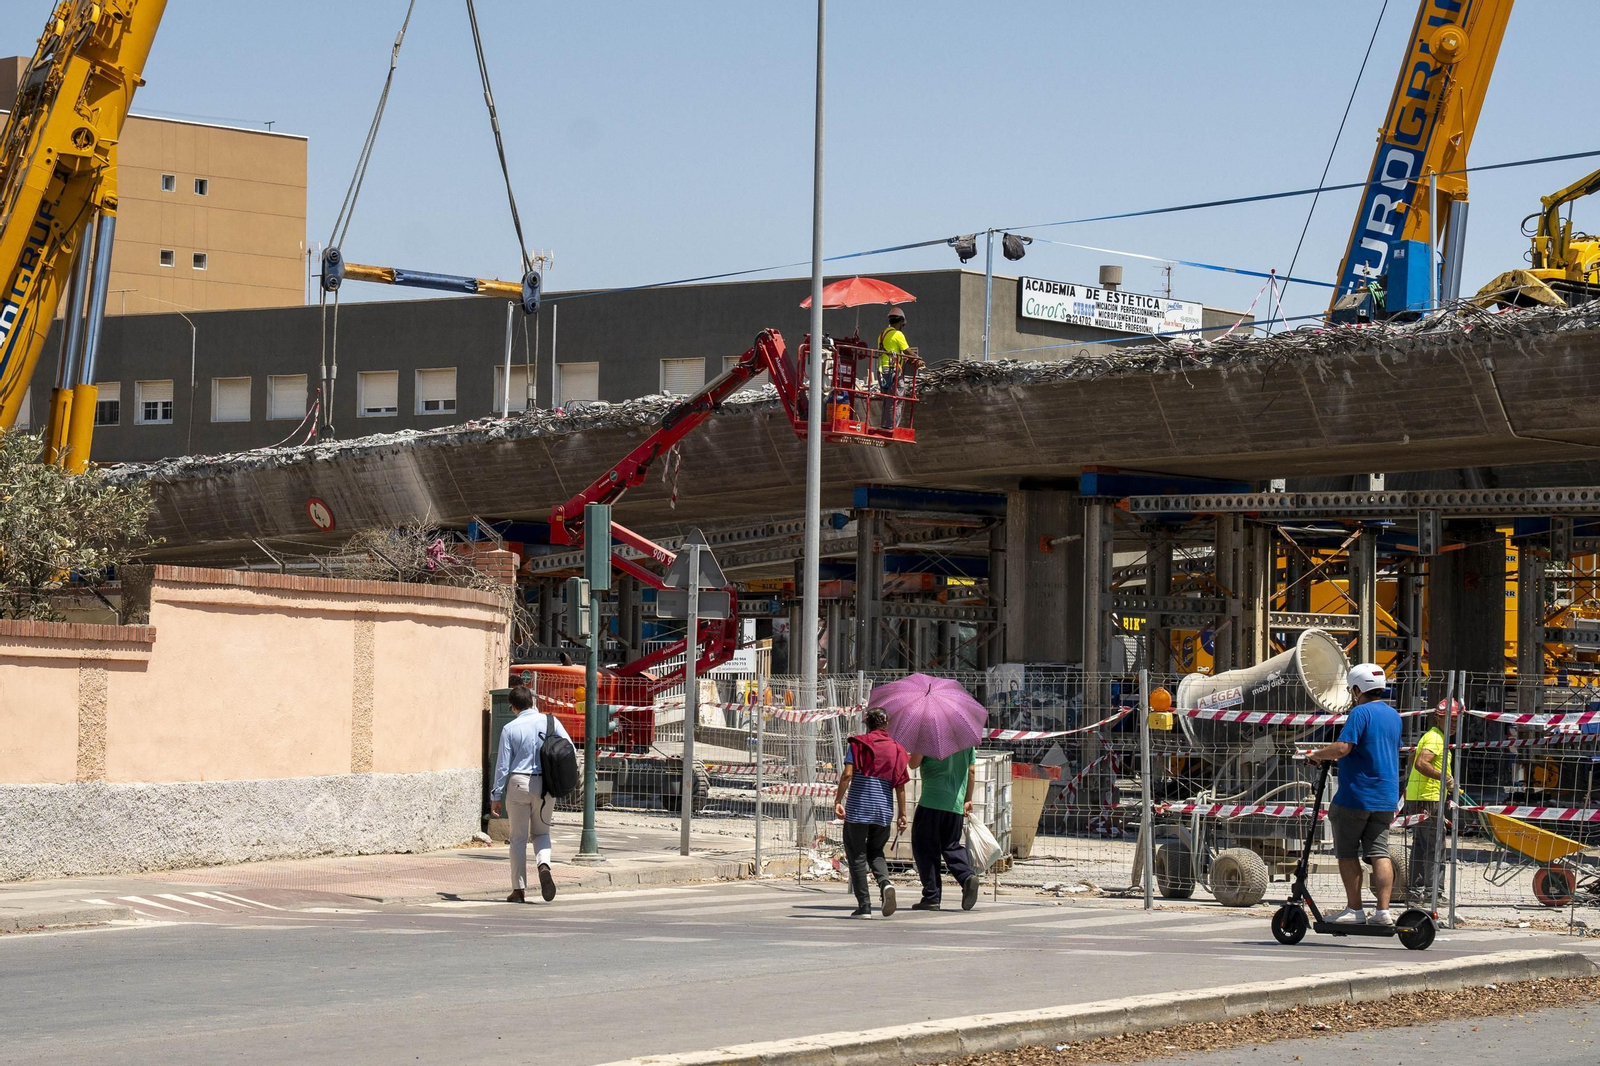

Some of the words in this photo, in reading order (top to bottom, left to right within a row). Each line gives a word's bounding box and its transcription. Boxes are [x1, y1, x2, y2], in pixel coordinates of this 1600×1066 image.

[1025, 279, 1076, 298] ACADEMIA
[1086, 288, 1100, 301] DE
[1107, 291, 1160, 310] ESTETICA
[1025, 297, 1067, 320] Carol's
[1073, 301, 1095, 317] CURSOS
[1095, 301, 1118, 312] INICIACION
[1120, 305, 1165, 319] PERFECCIONAMIENTO
[1094, 318, 1123, 330] MAQUILLAJE
[1098, 311, 1148, 325] MICROPIGMENTACION
[652, 547, 666, 563] 900
[1199, 697, 1209, 709] A.
[1211, 688, 1242, 704] EGEA
